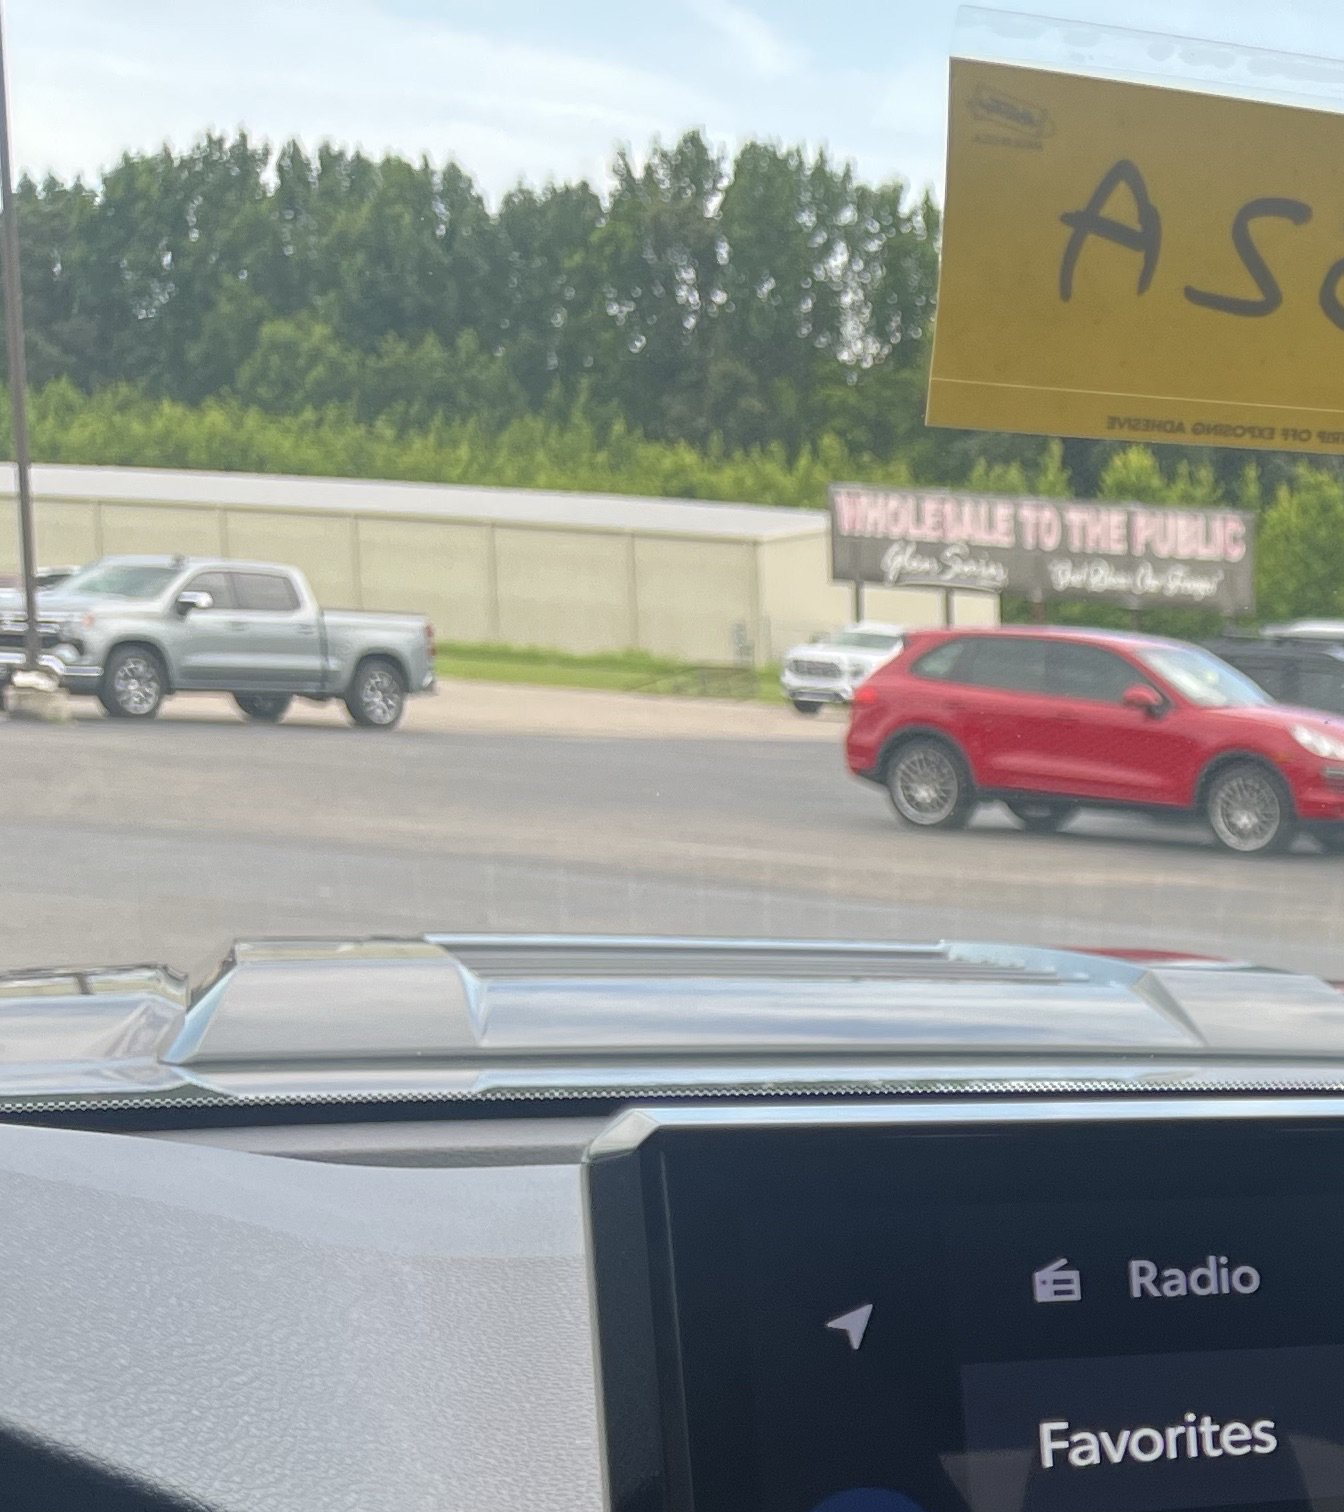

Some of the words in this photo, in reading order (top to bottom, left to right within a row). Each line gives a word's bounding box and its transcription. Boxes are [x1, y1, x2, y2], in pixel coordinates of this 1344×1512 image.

[1017, 501, 1061, 551] TO
[1063, 506, 1128, 554] THE
[1130, 509, 1247, 562] PUBLIC
[1128, 1256, 1262, 1299] Radio
[1039, 1411, 1279, 1468] Favorites
